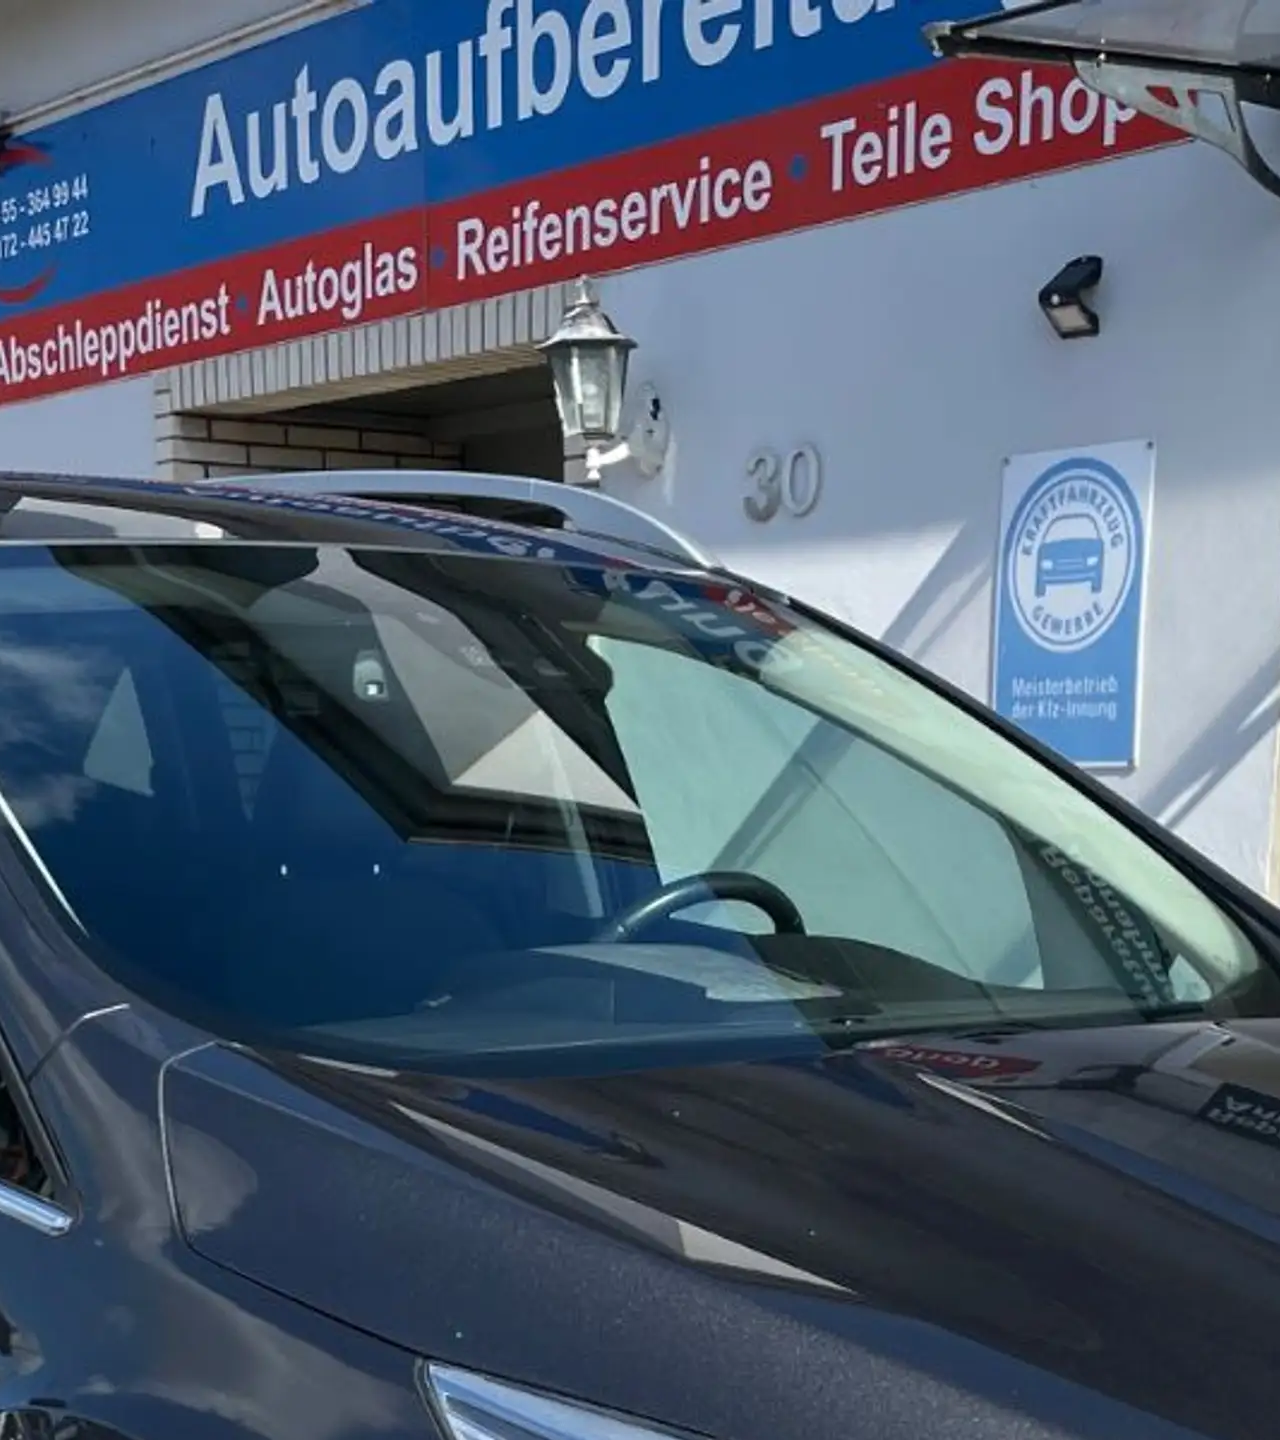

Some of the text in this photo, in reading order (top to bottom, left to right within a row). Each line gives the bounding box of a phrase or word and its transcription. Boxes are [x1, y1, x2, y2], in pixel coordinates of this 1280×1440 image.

[256, 242, 419, 326] Autoglas
[456, 158, 773, 281] Reifenservice
[820, 101, 952, 193] Teile
[974, 70, 1137, 156] Shop
[743, 446, 823, 523] 30
